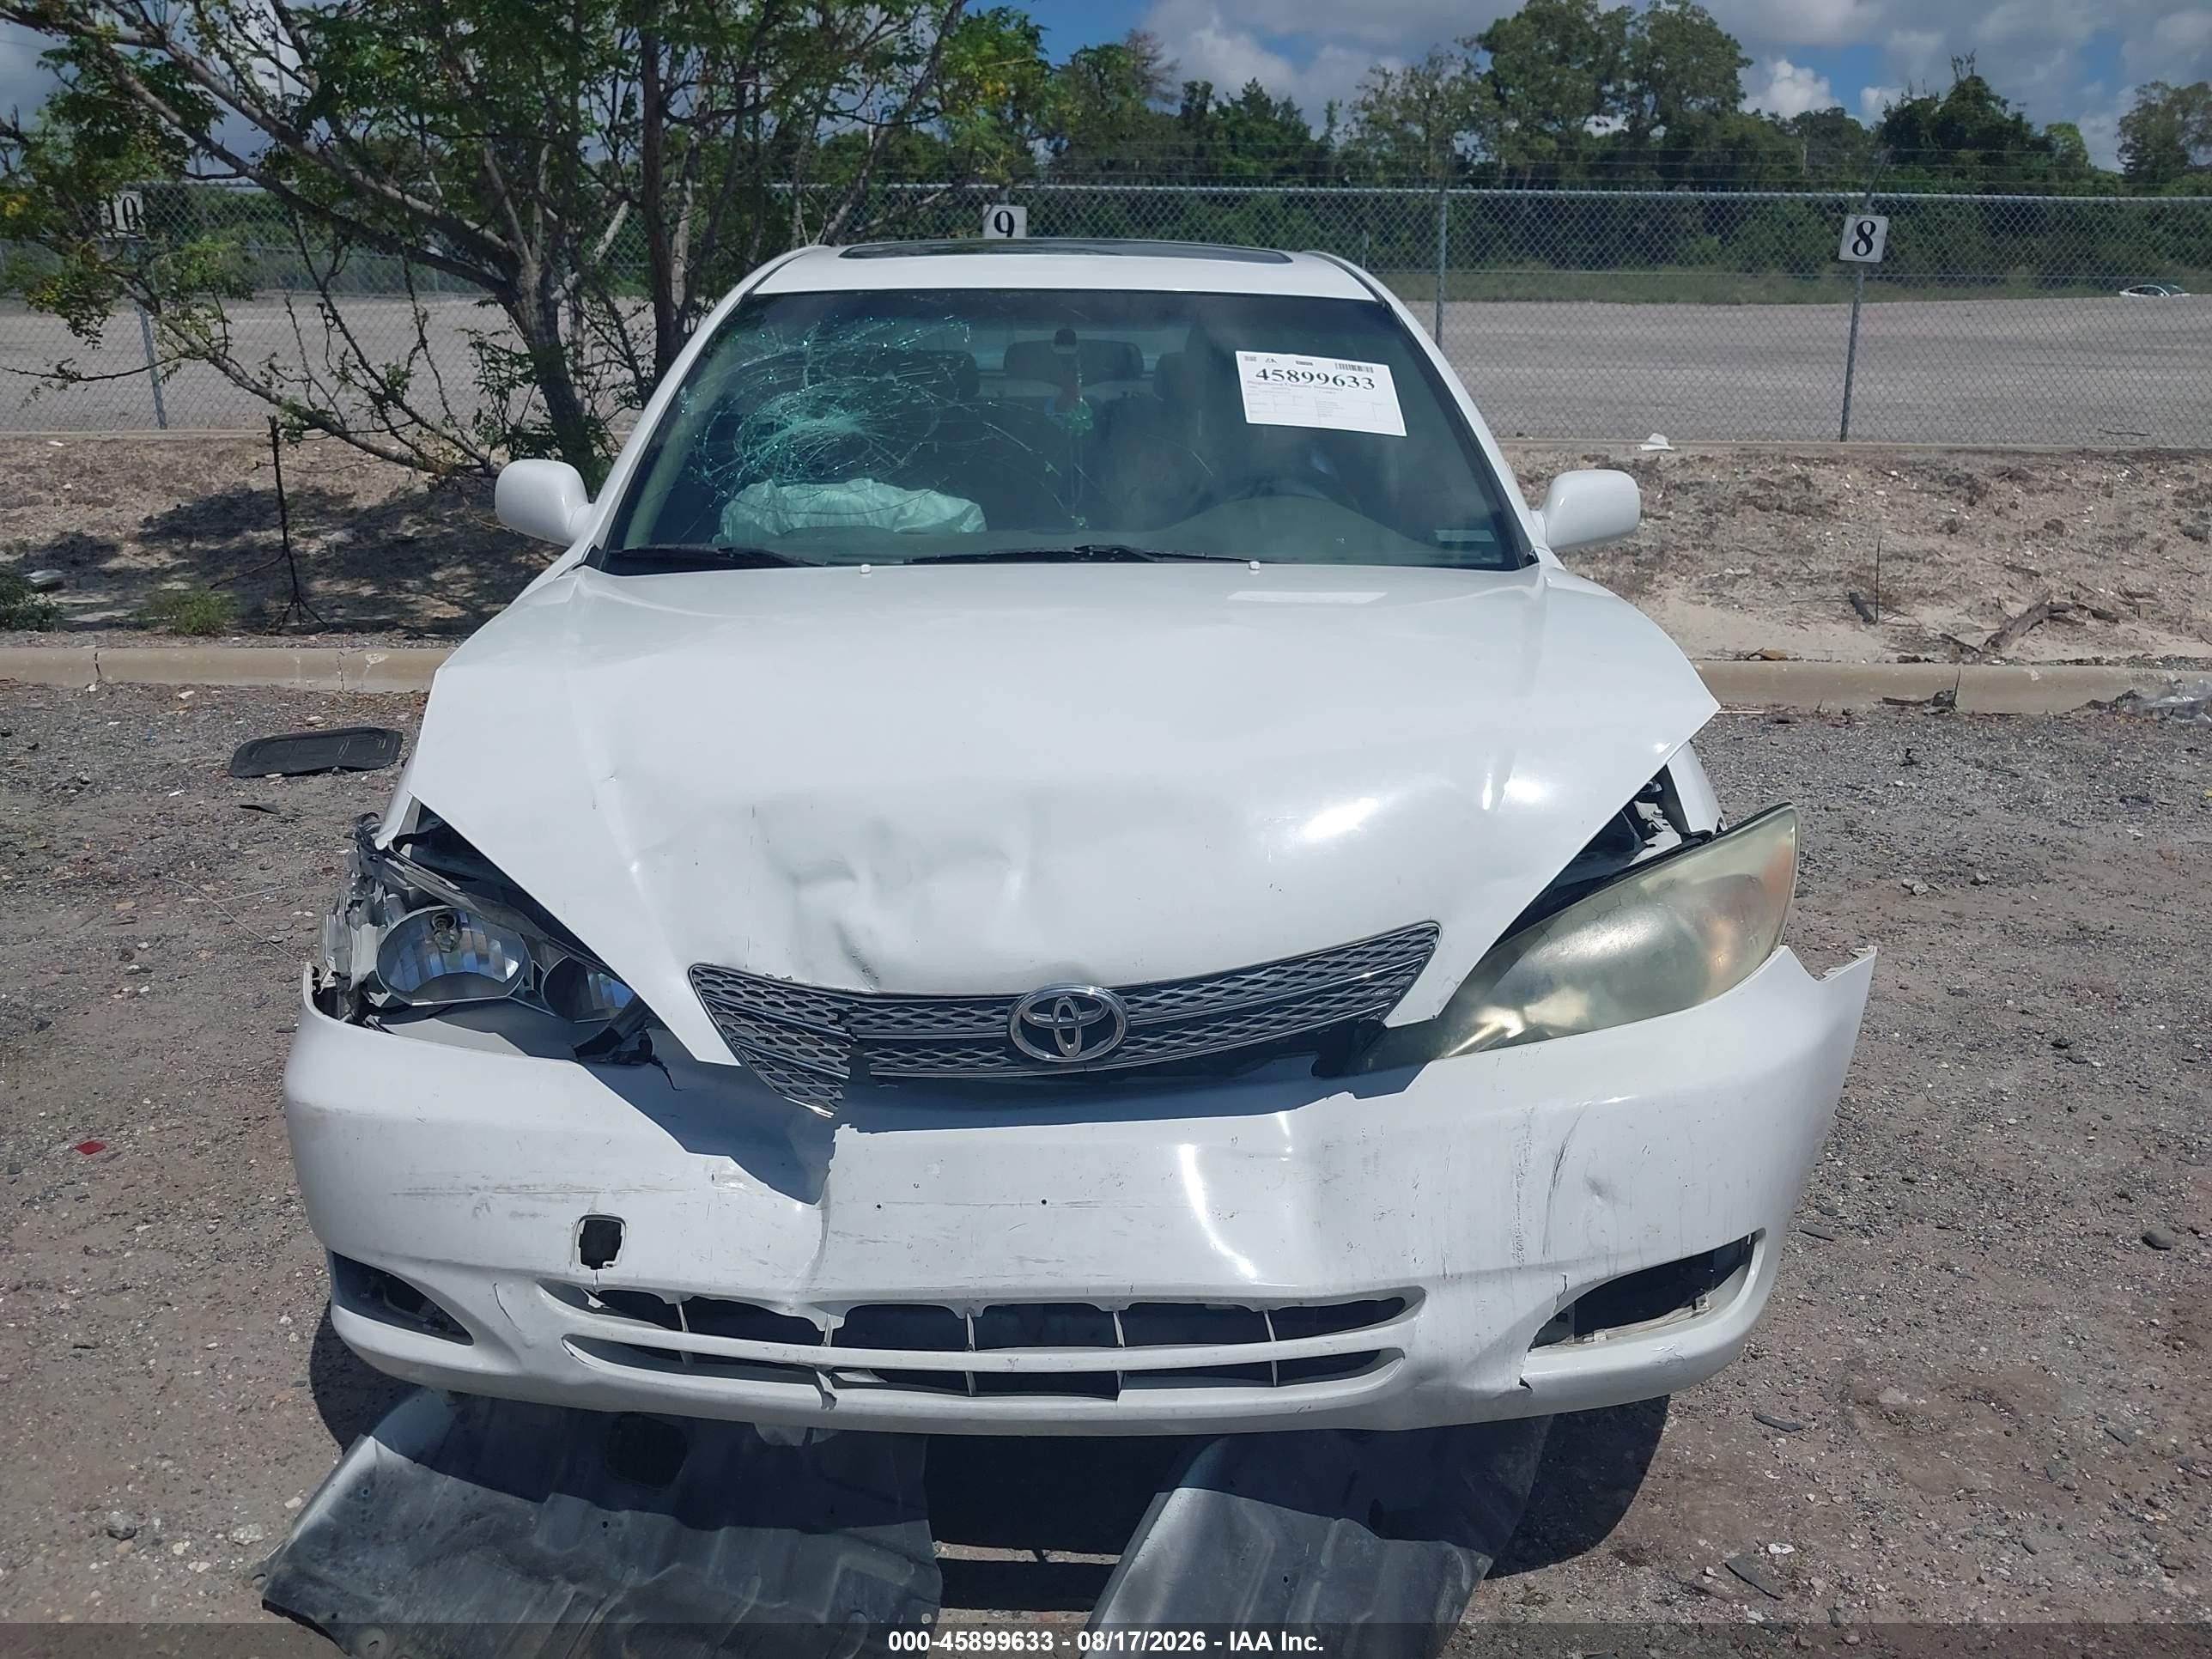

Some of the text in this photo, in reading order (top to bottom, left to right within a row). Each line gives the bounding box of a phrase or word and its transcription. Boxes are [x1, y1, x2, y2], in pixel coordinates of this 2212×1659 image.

[994, 210, 1014, 238] 9
[1852, 220, 1876, 257] 8
[1255, 368, 1375, 391] 45899633
